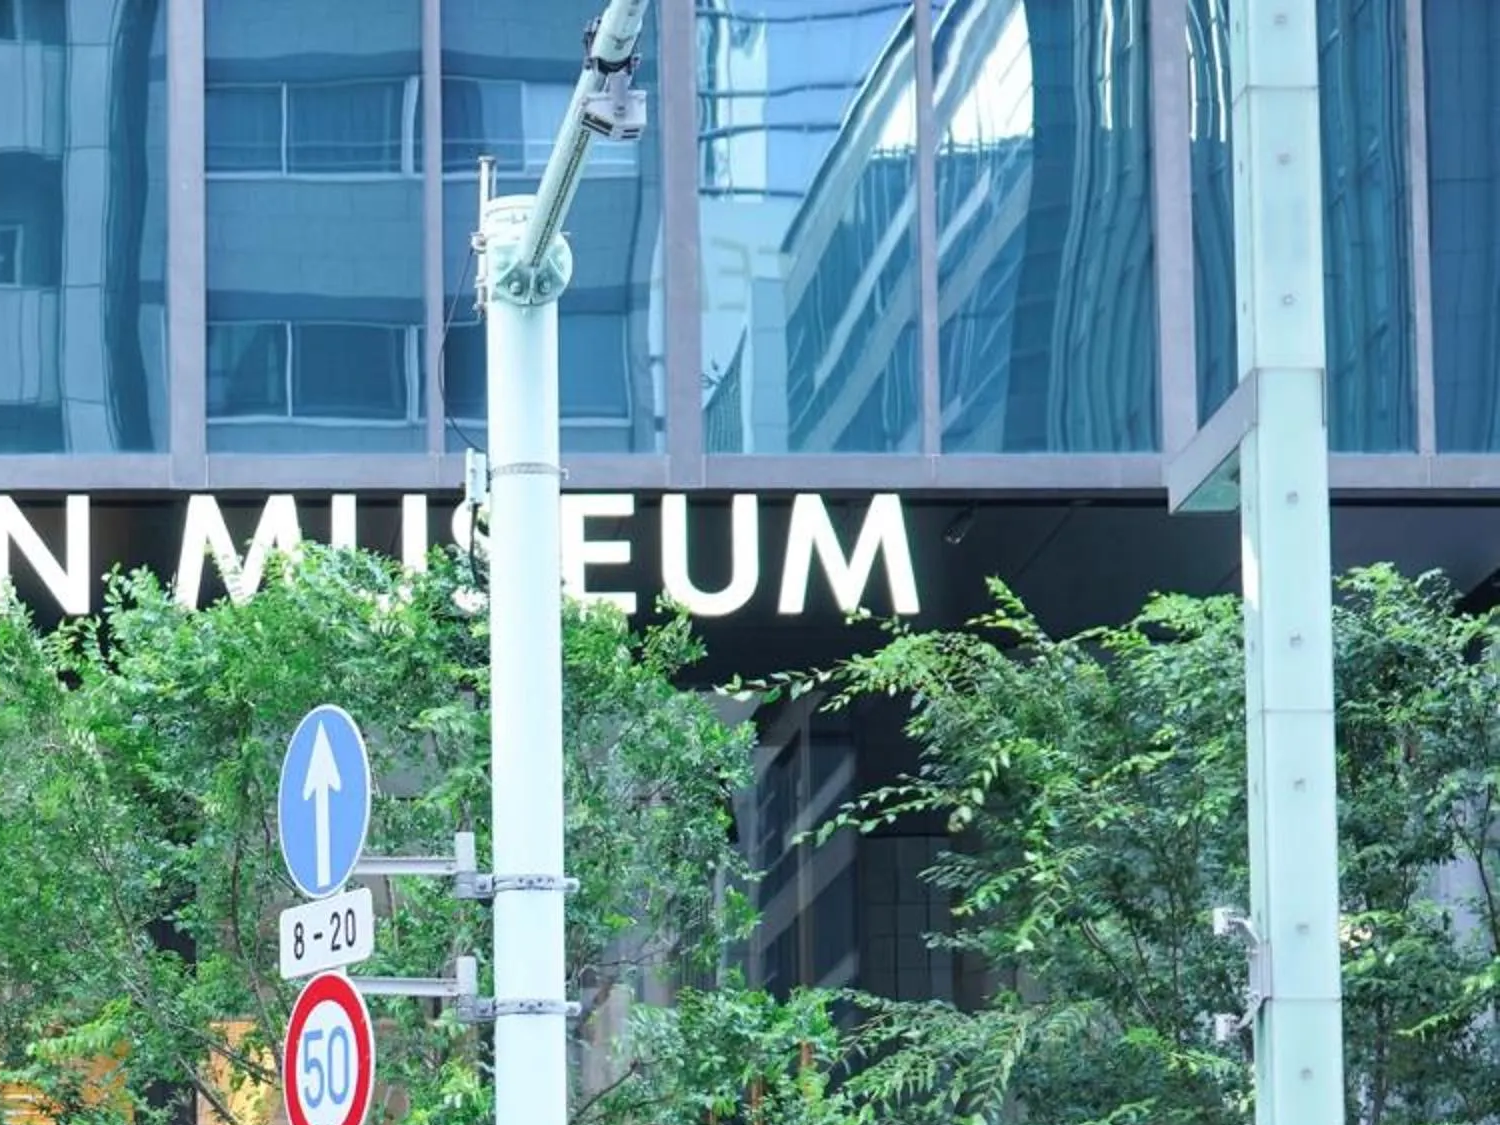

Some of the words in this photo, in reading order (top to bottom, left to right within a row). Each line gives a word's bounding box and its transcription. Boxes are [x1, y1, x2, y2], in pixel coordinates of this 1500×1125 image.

[175, 493, 921, 616] MUEUM
[292, 907, 357, 961] 8-20
[302, 1025, 350, 1109] 50
